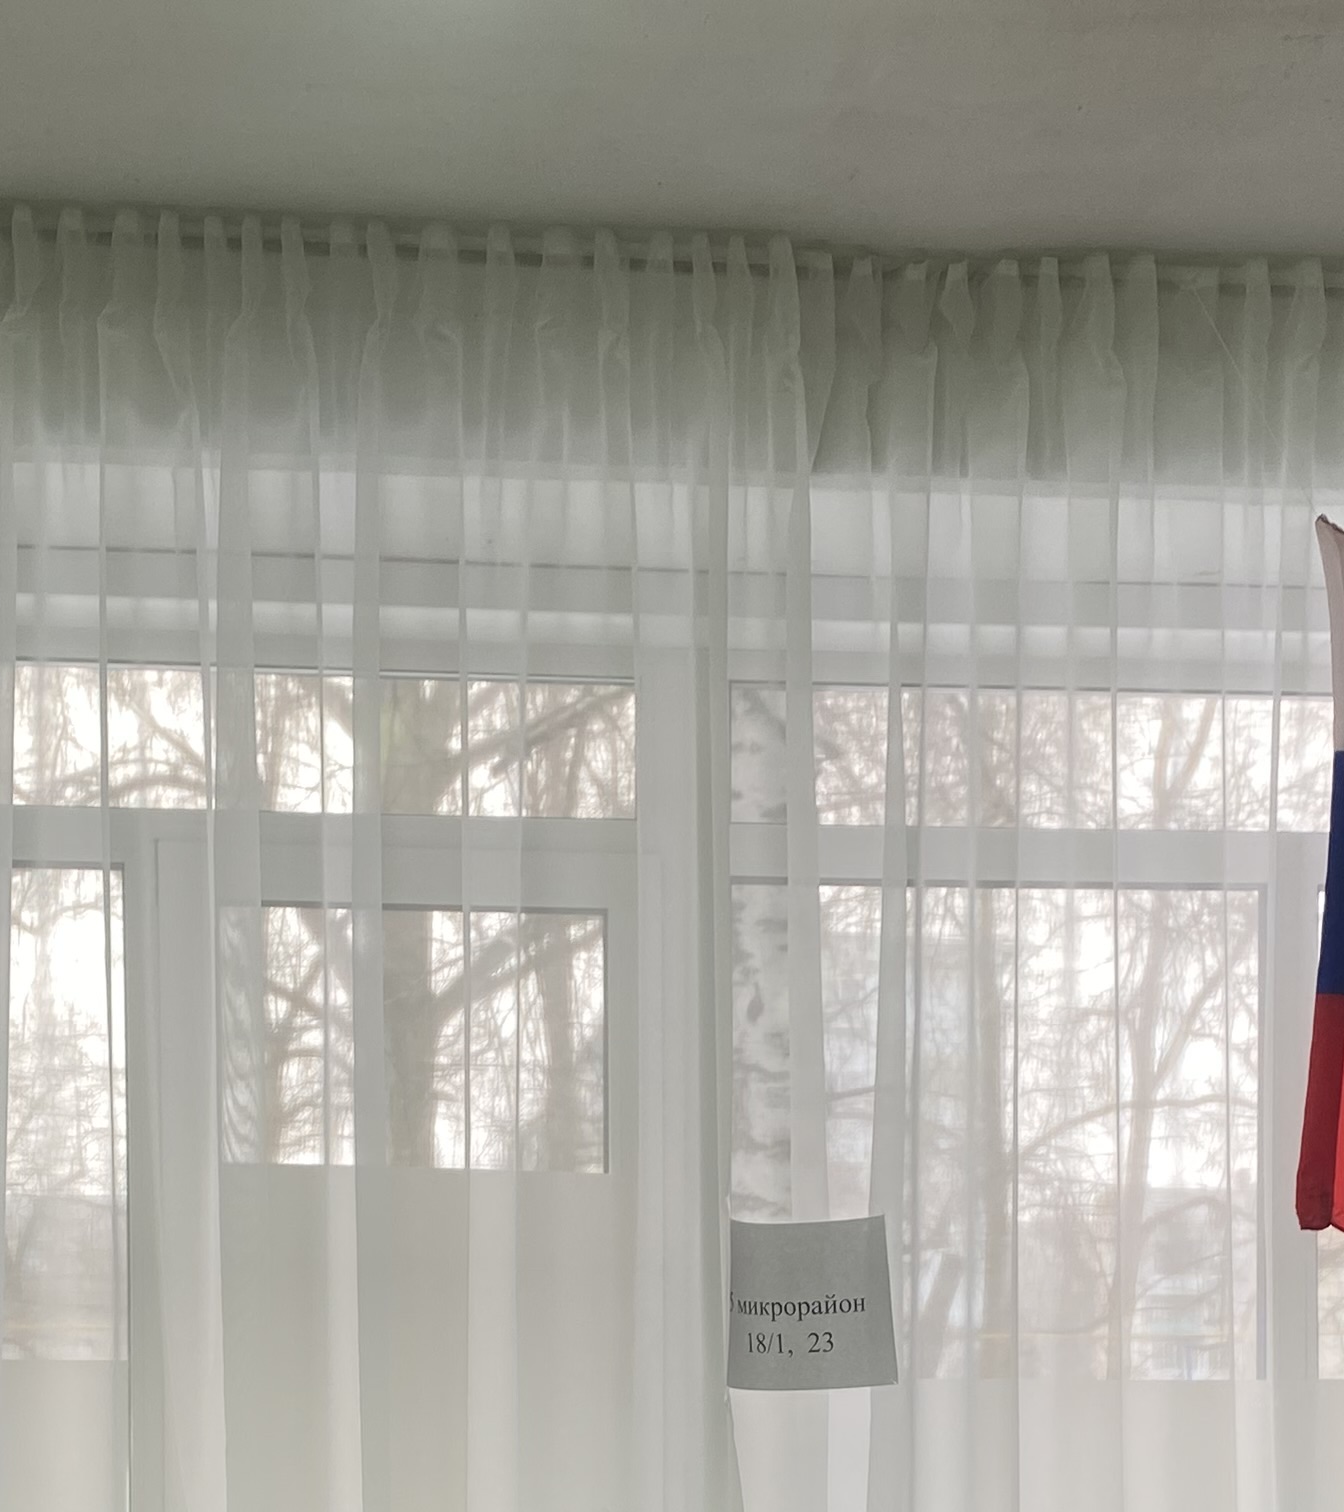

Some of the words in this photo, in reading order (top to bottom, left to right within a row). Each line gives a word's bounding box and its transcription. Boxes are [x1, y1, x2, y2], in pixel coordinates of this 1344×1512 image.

[737, 1293, 866, 1322] микрорайон
[747, 1332, 794, 1358] 18/1,
[807, 1331, 834, 1354] 23
